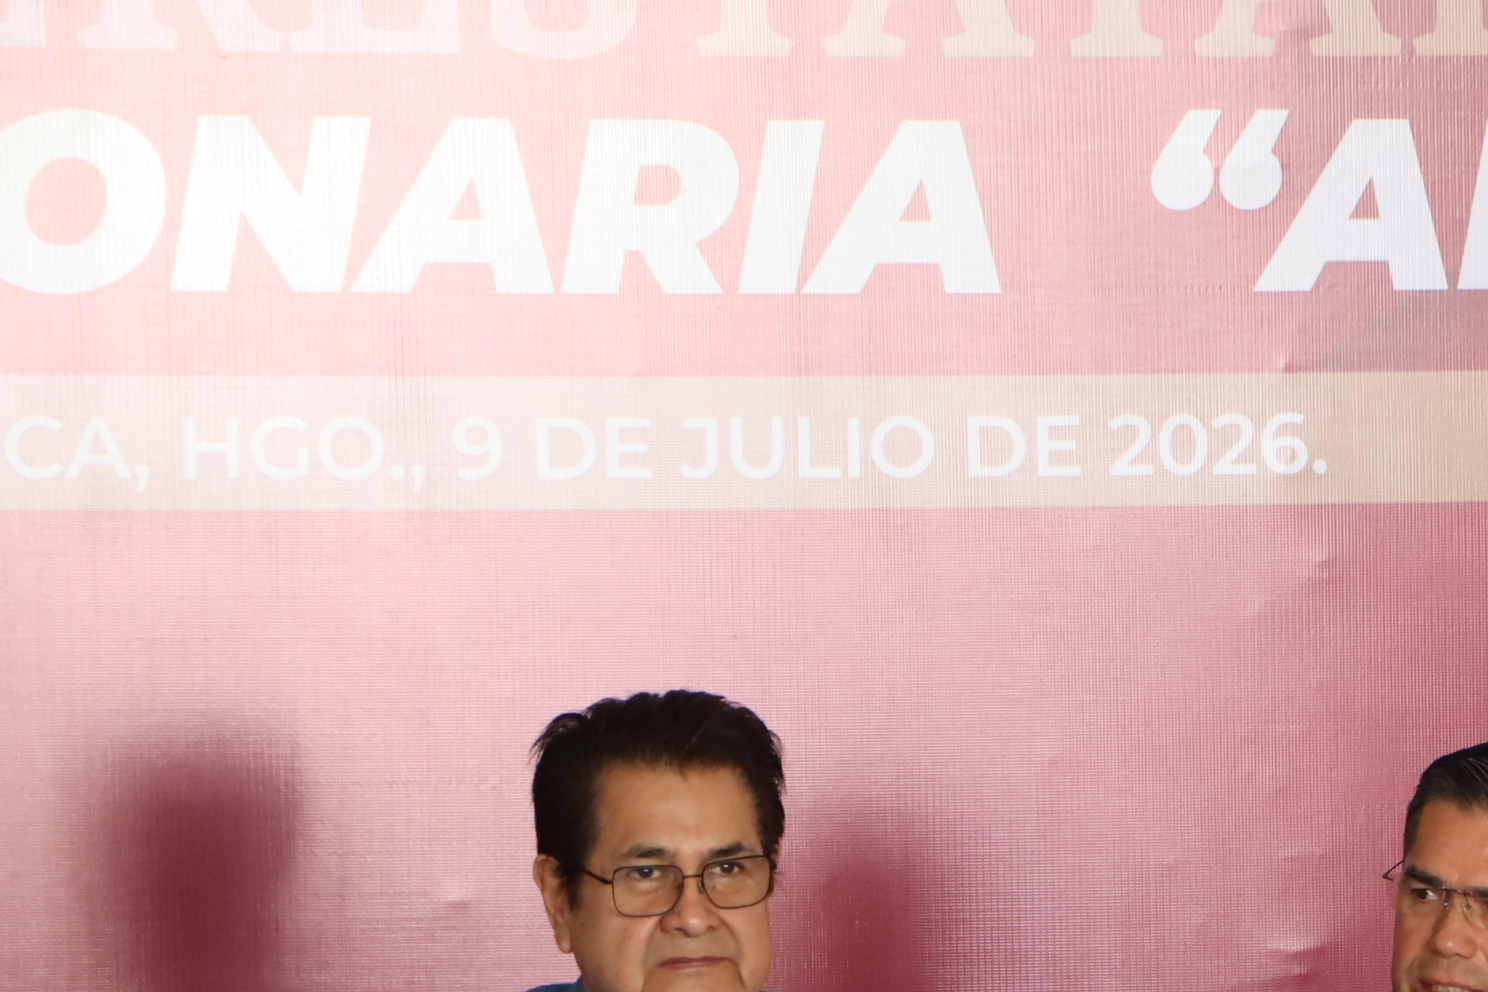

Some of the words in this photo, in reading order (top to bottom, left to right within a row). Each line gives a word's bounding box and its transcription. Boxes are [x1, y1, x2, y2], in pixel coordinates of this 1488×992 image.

[0, 109, 1002, 295] ONARIA
[4, 415, 149, 492] CA,
[183, 415, 426, 492] HGO.,
[453, 416, 502, 480] 9
[535, 417, 653, 479] DE
[680, 415, 936, 480] JULIO
[966, 415, 1082, 478] DE
[1107, 412, 1328, 477] 2026.
